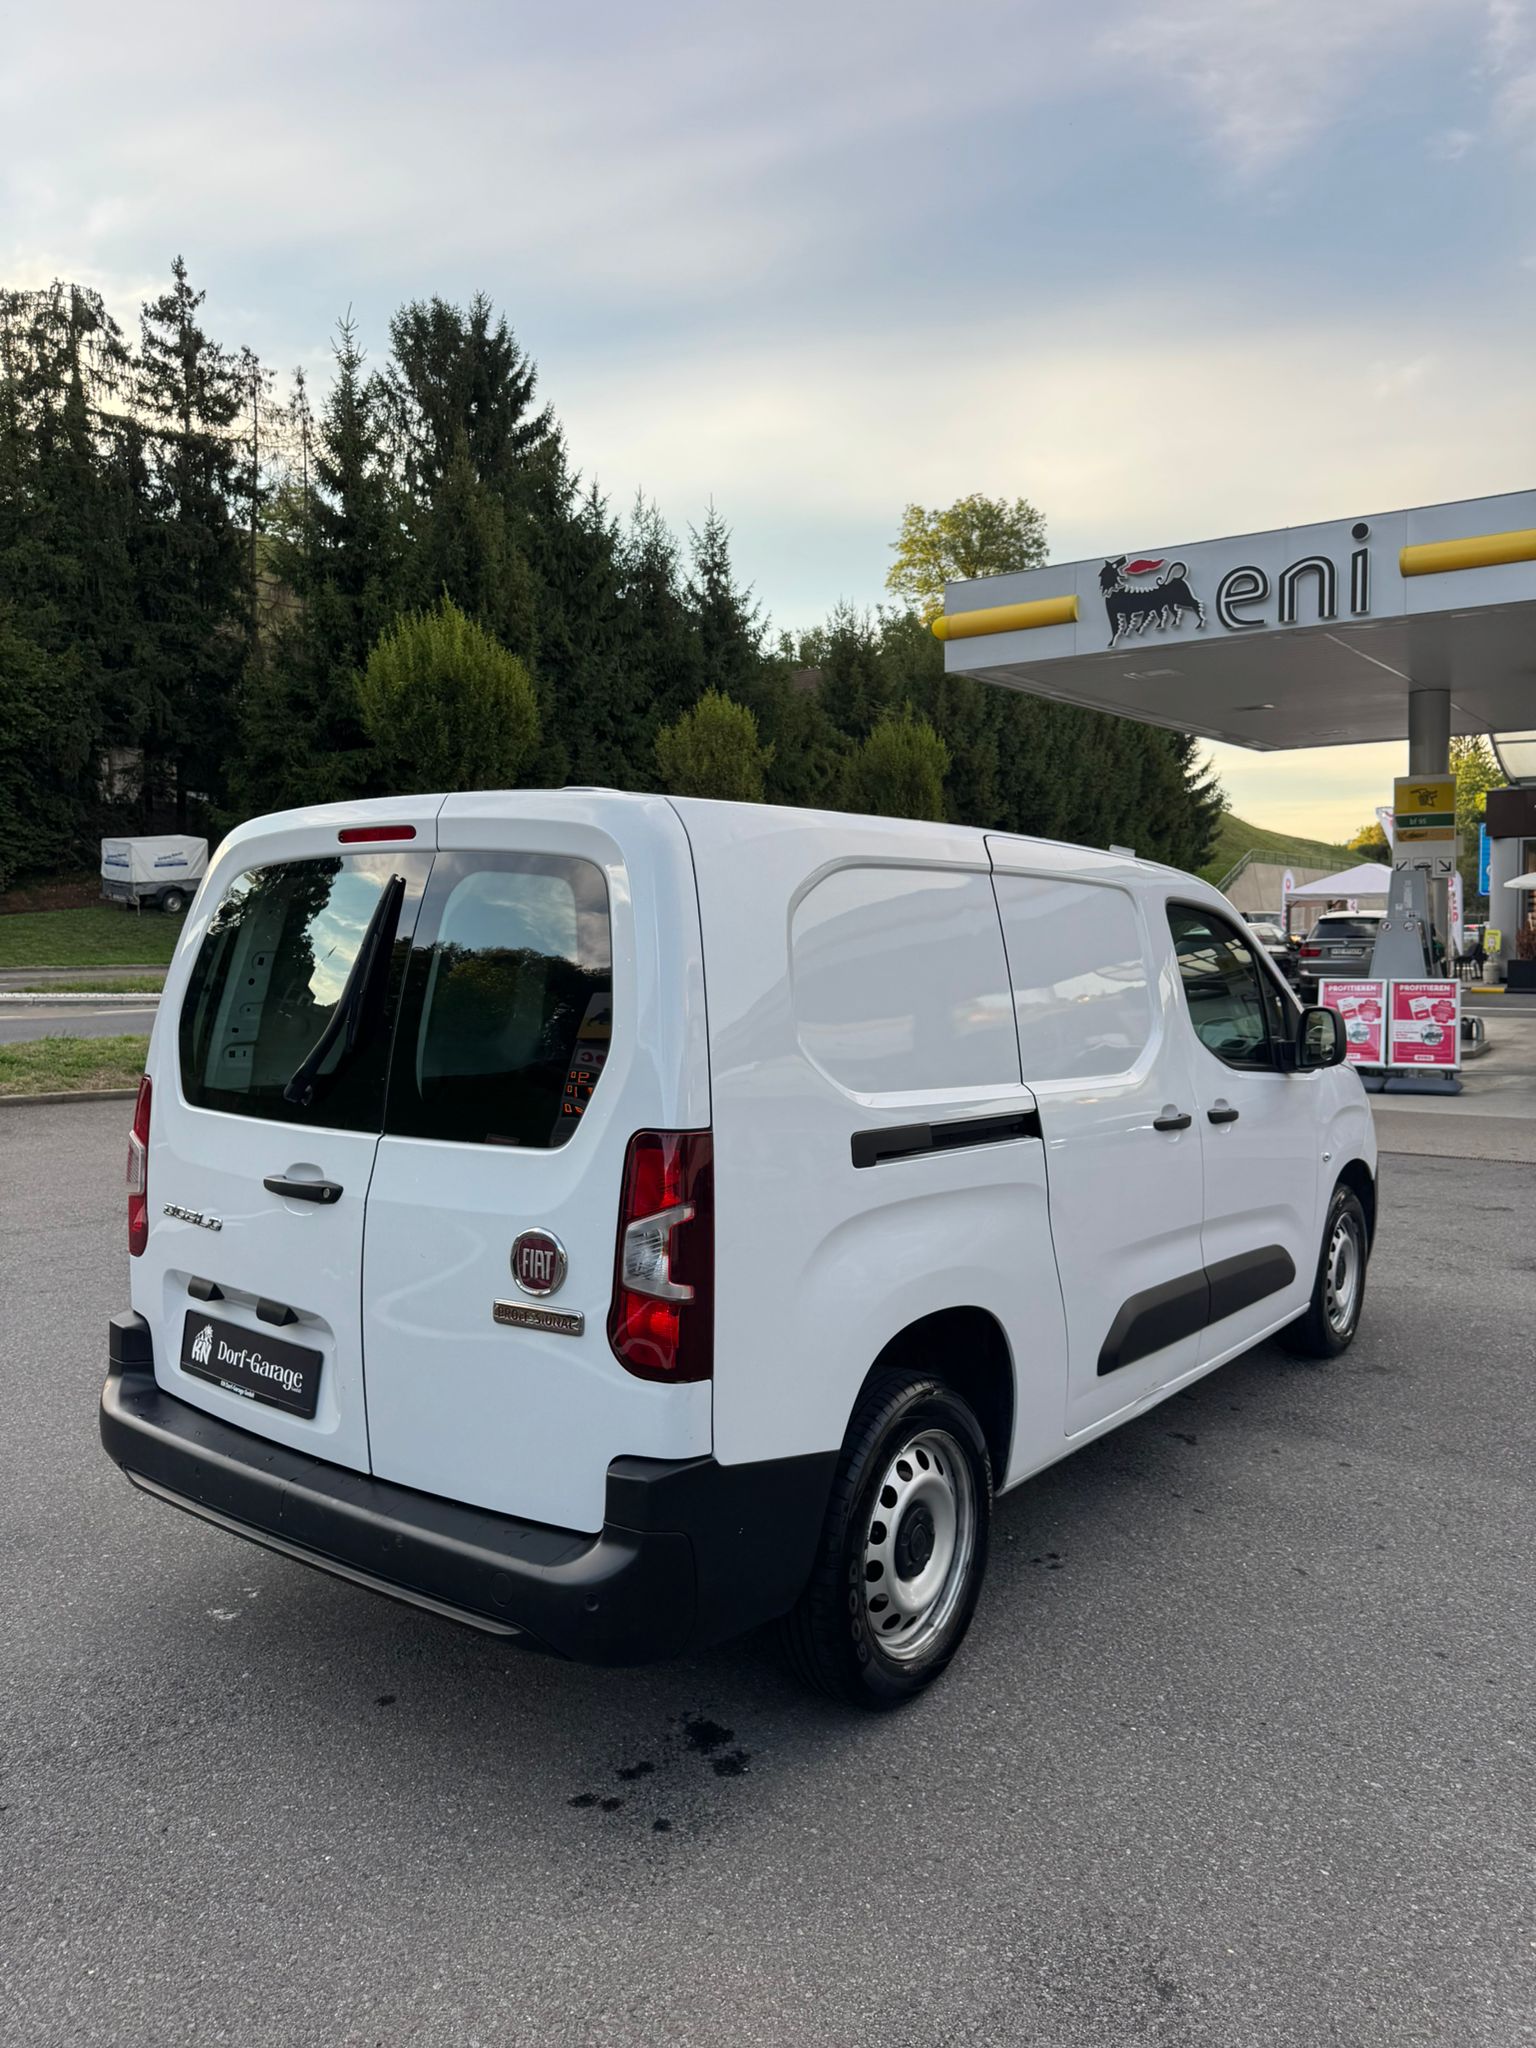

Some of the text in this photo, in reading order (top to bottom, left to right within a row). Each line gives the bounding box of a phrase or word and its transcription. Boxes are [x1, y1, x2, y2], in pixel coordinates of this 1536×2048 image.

[1216, 522, 1370, 630] eni
[1328, 984, 1377, 992] PROFITIEREN
[1399, 984, 1451, 992] PROFITIEREN
[522, 1247, 554, 1280] FIAT
[495, 1304, 580, 1331] PROFESSIONAL
[217, 1340, 303, 1391] Dorf-Garage
